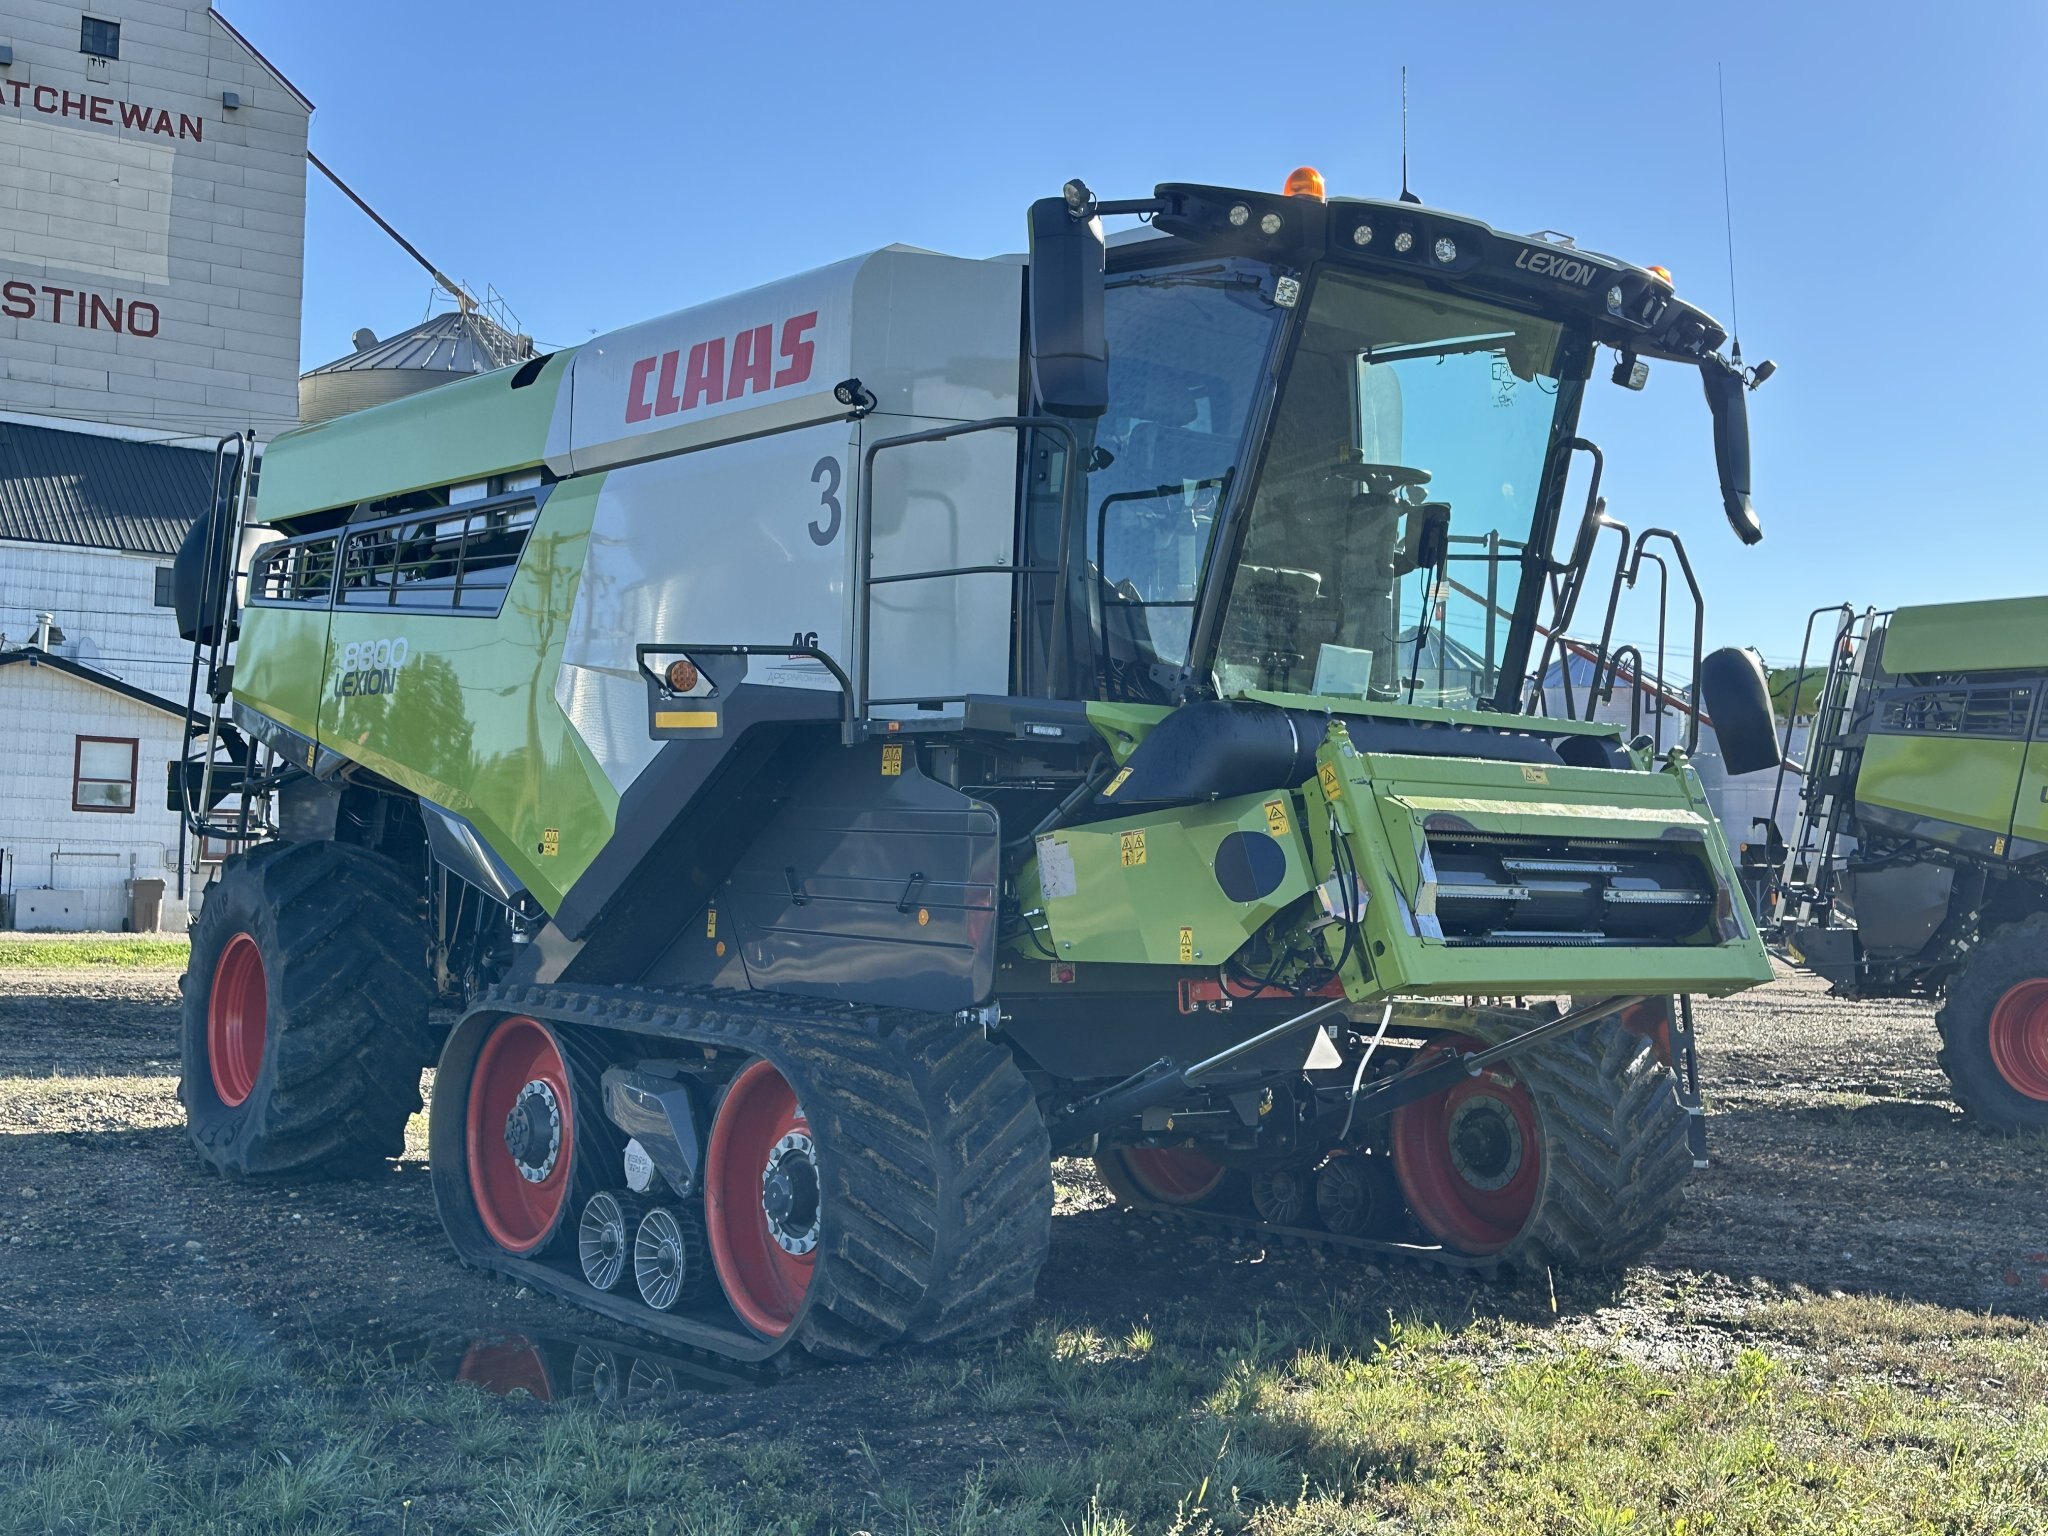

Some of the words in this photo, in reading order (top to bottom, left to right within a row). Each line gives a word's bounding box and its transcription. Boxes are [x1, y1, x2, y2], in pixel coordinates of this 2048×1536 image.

[1515, 248, 1597, 286] LEXION
[1, 280, 160, 338] STINO
[625, 310, 819, 424] CLAAS
[808, 455, 842, 546] 3
[343, 637, 409, 672] 8800
[792, 631, 819, 649] AG
[334, 667, 397, 698] LEXION
